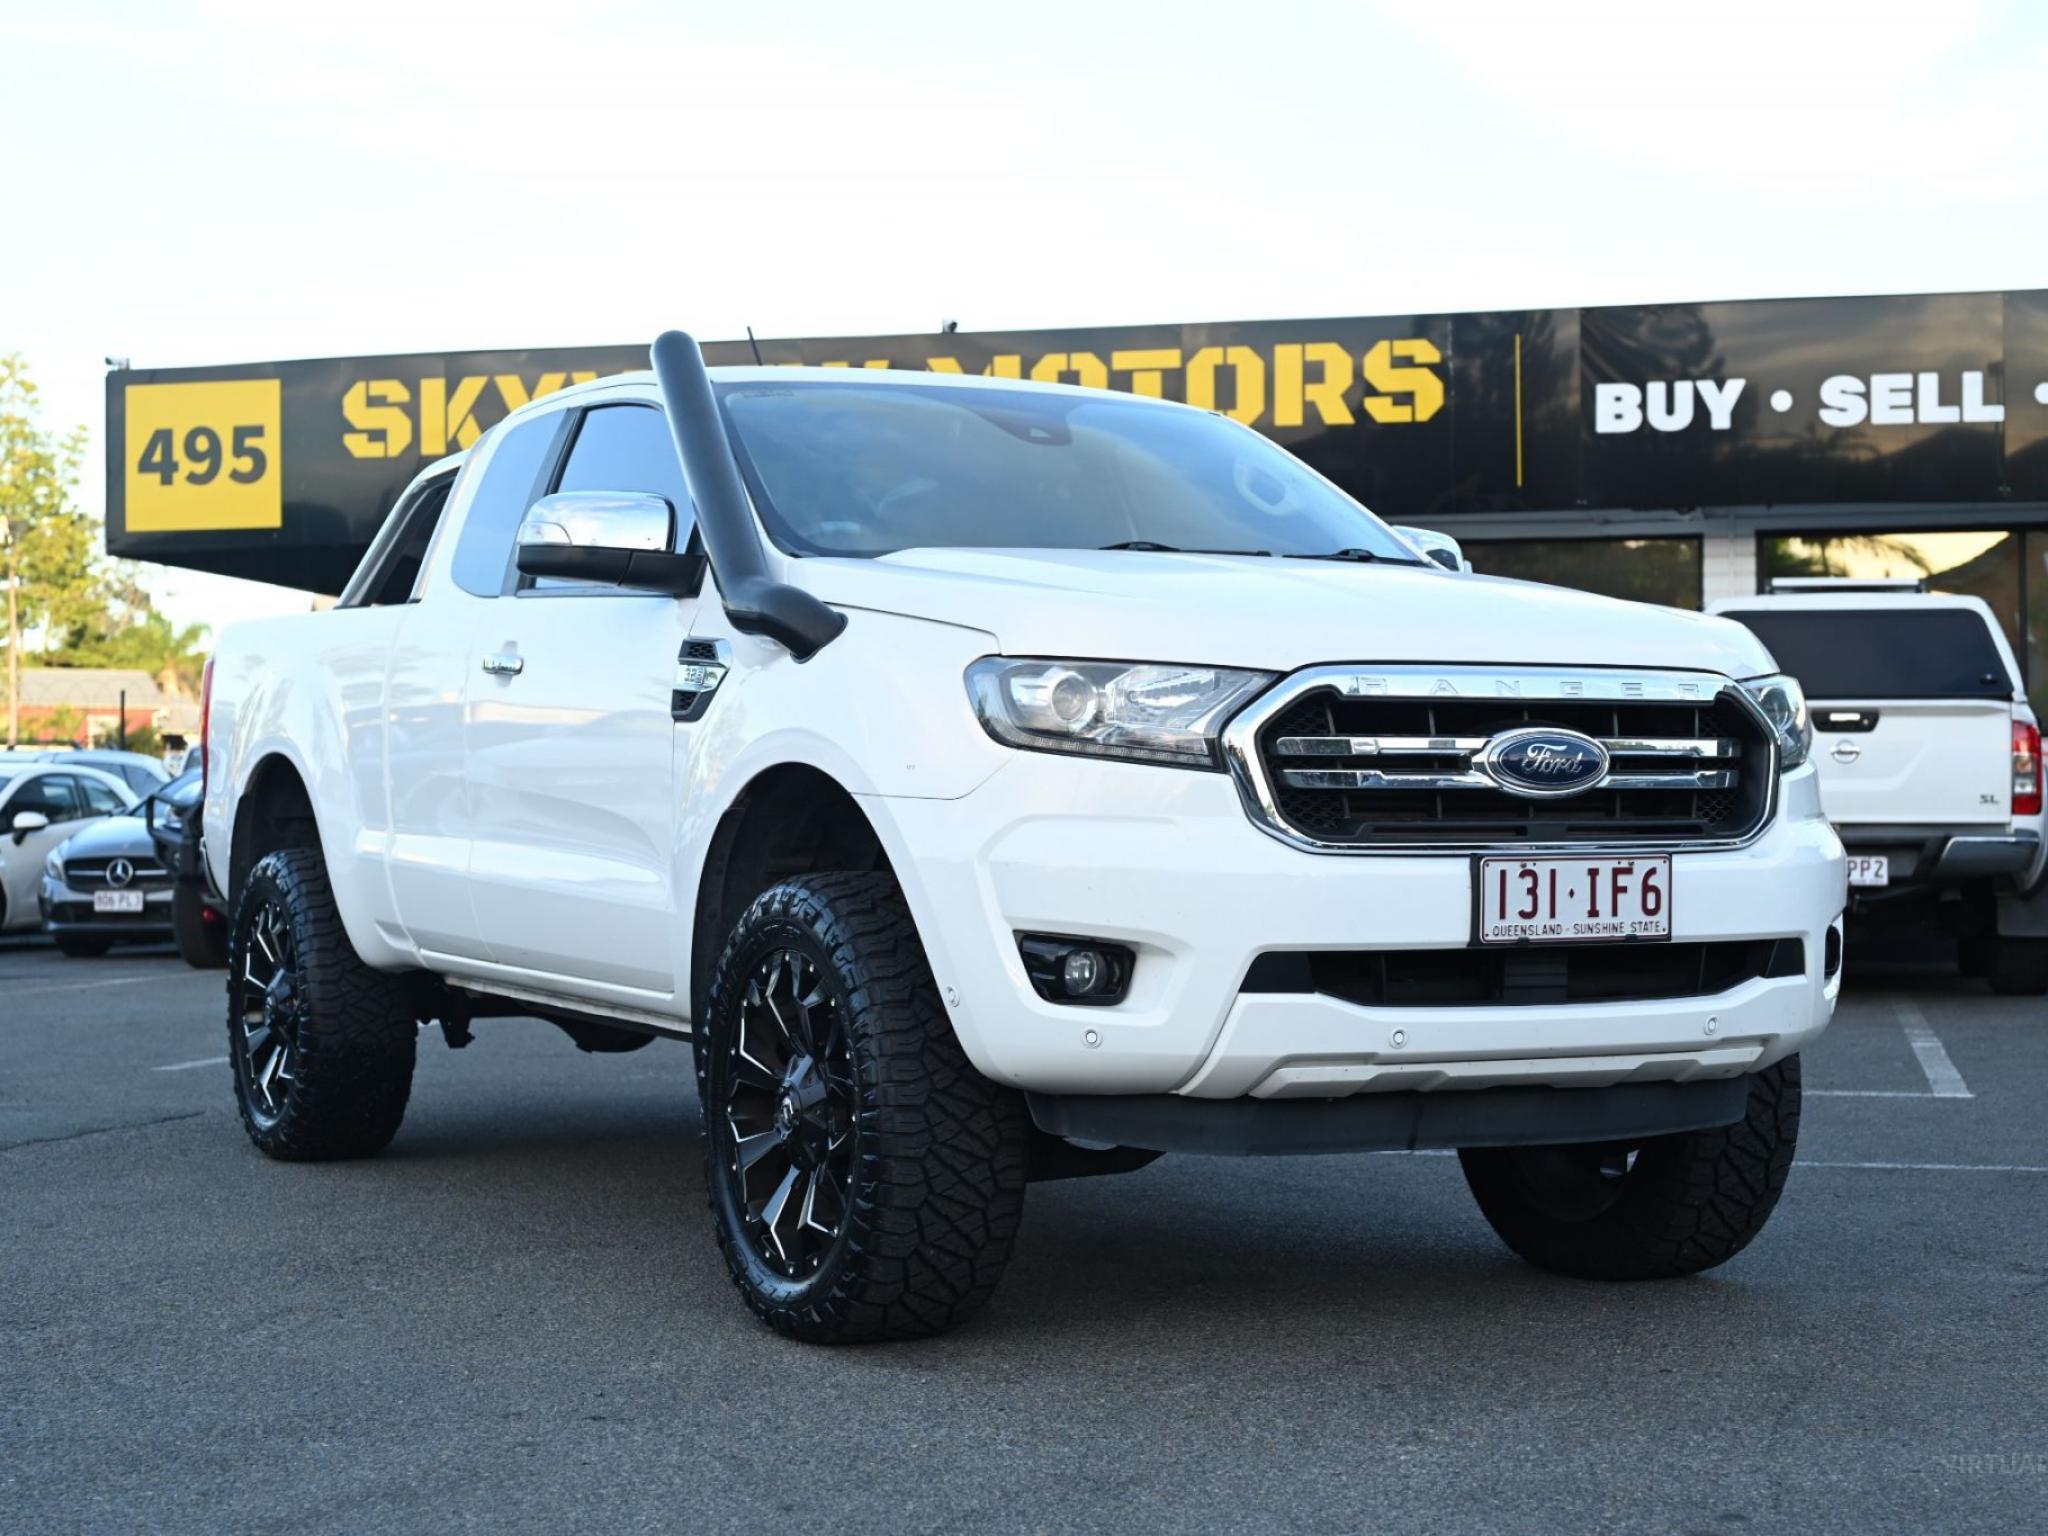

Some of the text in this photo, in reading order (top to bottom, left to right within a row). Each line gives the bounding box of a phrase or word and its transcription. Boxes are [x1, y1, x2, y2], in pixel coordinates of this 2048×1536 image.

[926, 338, 1444, 427] TORS
[1595, 371, 2005, 433] BUY SELL
[137, 424, 267, 486] 495
[1356, 676, 1700, 699] RANGER
[1521, 743, 1583, 774] Ford
[1492, 923, 1562, 937] QUEENSLAND
[1573, 921, 1625, 935] SUNSHINE
[1631, 920, 1661, 933] STATE
